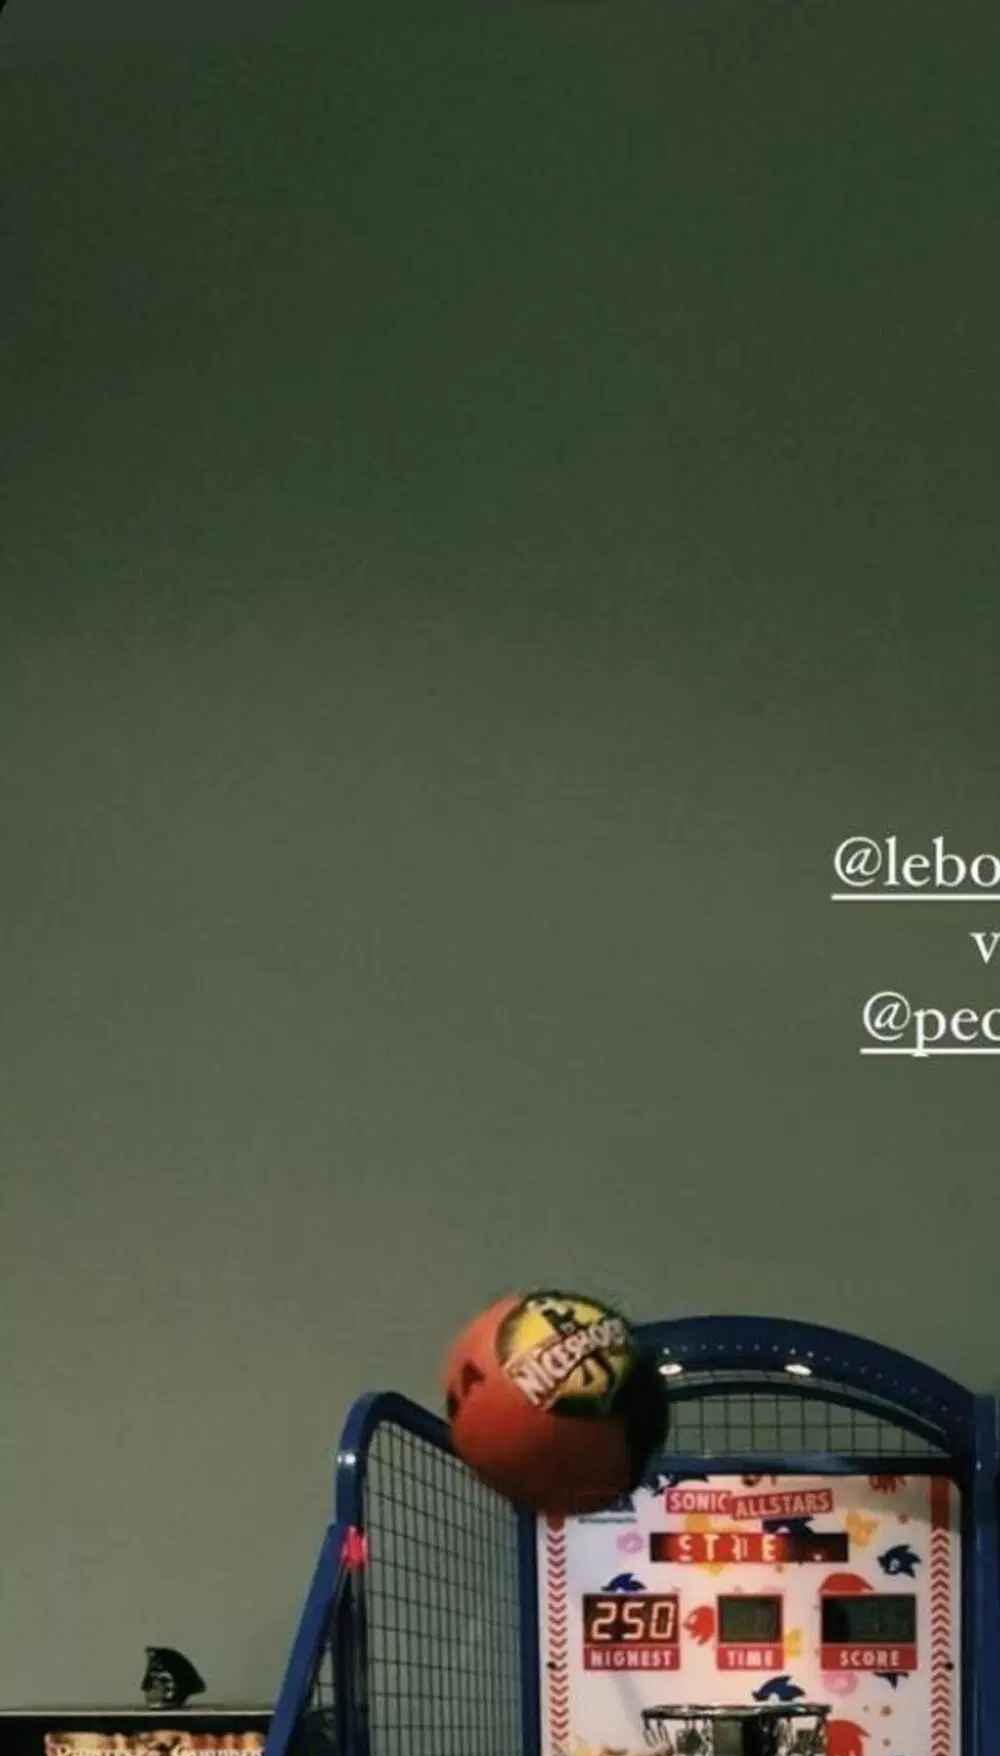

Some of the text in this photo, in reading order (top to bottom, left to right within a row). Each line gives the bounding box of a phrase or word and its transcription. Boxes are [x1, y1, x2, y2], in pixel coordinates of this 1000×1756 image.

[669, 1490, 831, 1517] SONIC ALLSTARS
[591, 1601, 676, 1640] 250
[589, 1648, 672, 1668] HIGHEST
[727, 1648, 774, 1668] TIME
[840, 1649, 899, 1667] SCORE
